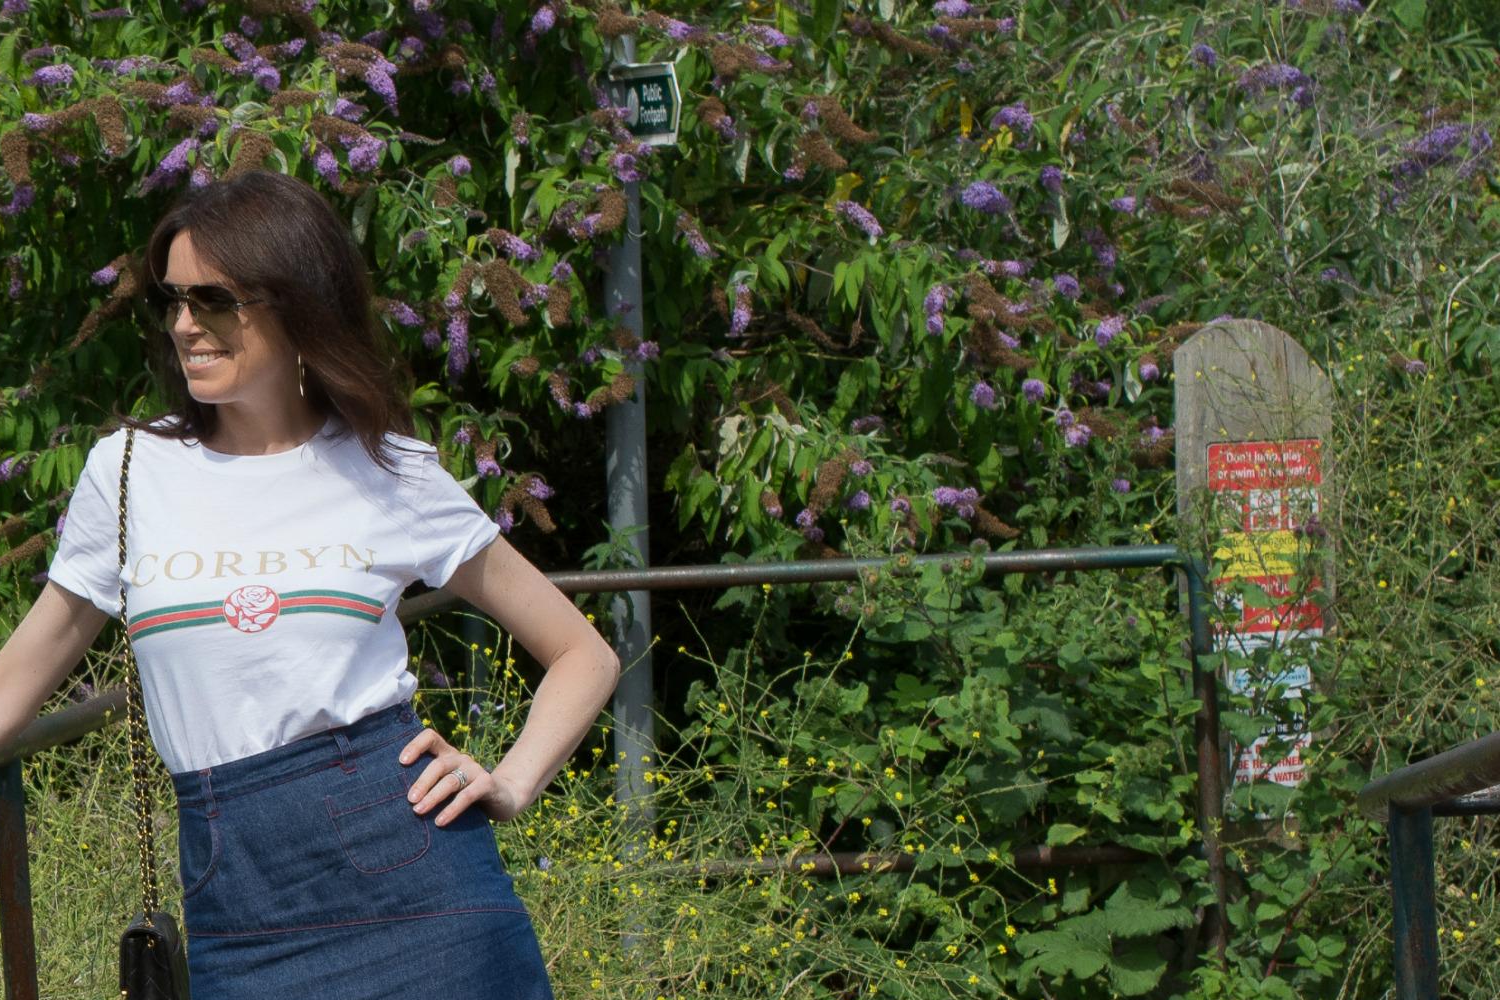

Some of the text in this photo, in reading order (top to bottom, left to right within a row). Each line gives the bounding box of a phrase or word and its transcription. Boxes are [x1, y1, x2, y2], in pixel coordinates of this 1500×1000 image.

[642, 84, 662, 102] Public
[640, 105, 667, 126] Footpath
[1226, 451, 1252, 463] Don't
[1282, 448, 1301, 463] play
[1218, 470, 1228, 480] or
[1230, 467, 1255, 479] swim
[131, 543, 377, 588] CORBYN
